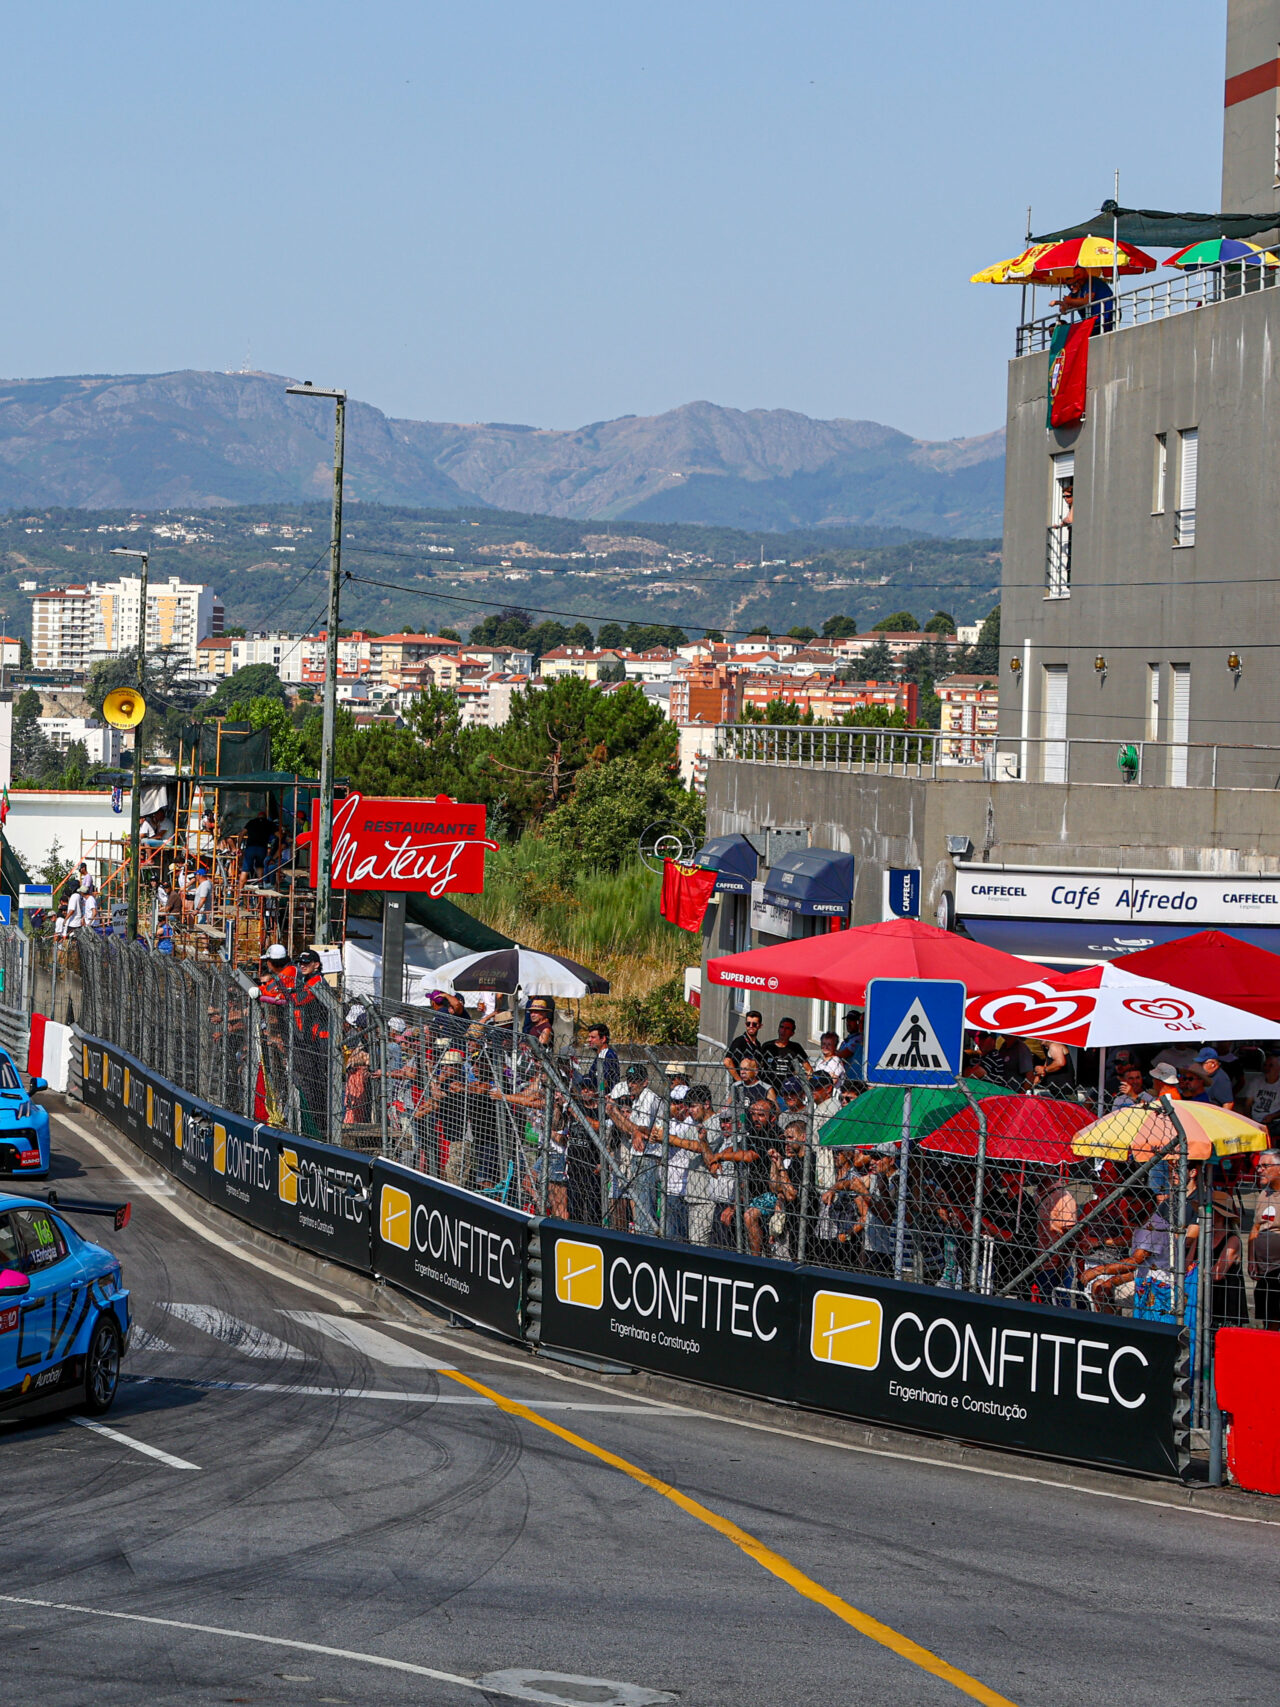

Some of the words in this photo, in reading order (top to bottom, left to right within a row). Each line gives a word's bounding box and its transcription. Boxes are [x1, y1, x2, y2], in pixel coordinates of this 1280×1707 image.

[363, 821, 477, 836] RESTAURANTE
[1051, 886, 1100, 909] Café
[1116, 889, 1198, 911] Alfredo
[720, 972, 744, 983] SUPER
[745, 974, 766, 986] BOCK
[226, 1134, 270, 1191] CONFITEC
[299, 1159, 363, 1224] CONFITEC
[33, 1219, 54, 1246] 168
[414, 1204, 515, 1289] CONFITEC
[609, 1257, 780, 1342] CONFITEC
[610, 1318, 649, 1341] Engenharia
[651, 1333, 657, 1343] e
[658, 1332, 700, 1354] Construção
[35, 1367, 63, 1388] Aurobay
[890, 1312, 1149, 1409] CONFITEC
[889, 1380, 948, 1406] Engenharia
[951, 1397, 959, 1407] e
[962, 1395, 1027, 1421] Construção
